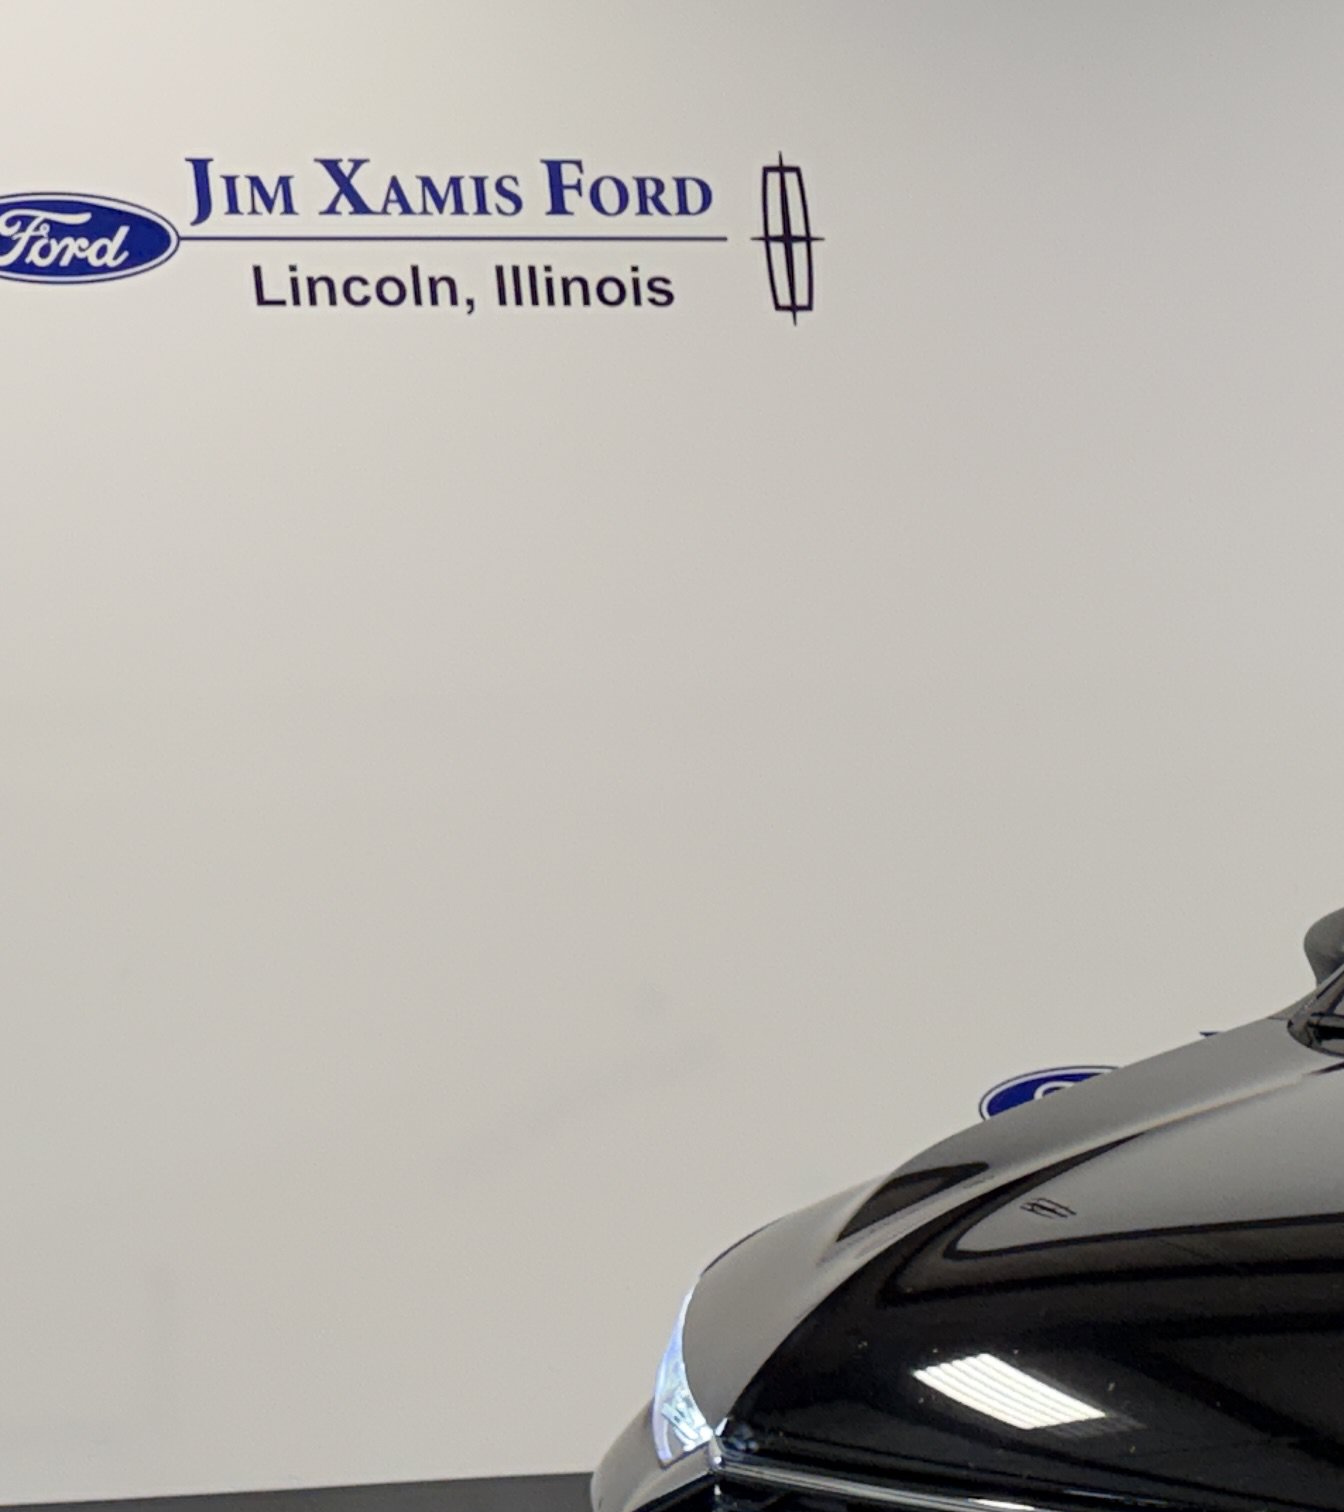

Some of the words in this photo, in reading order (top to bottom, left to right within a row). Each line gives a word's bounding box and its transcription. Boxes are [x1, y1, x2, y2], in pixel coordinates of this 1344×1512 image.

[0, 208, 130, 267] Ford
[252, 264, 475, 315] Lincoln,
[494, 264, 675, 308] Illinois
